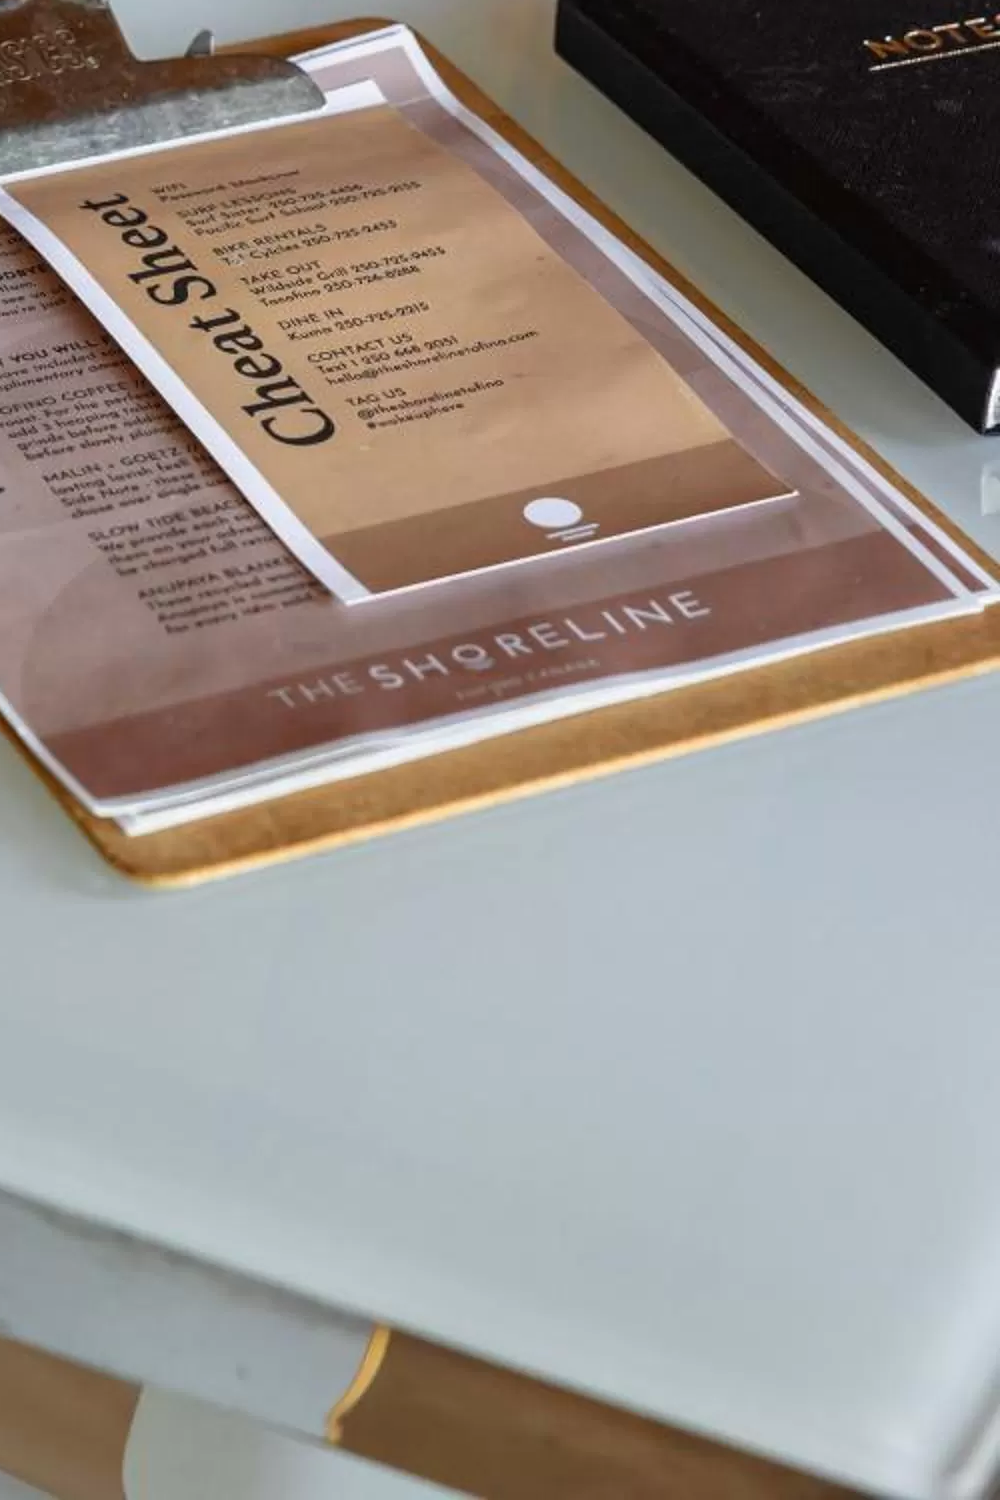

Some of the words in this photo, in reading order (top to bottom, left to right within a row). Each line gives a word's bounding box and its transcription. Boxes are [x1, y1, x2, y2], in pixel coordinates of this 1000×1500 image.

[175, 203, 221, 219] SURF
[219, 187, 301, 209] LESSONS
[79, 194, 217, 305] Sheet
[211, 241, 251, 256] BIKE
[251, 223, 328, 247] RENTALS
[239, 269, 283, 285] TAKE
[285, 259, 321, 275] OUT
[248, 276, 313, 295] Wildside
[315, 266, 349, 280] Grill
[276, 312, 321, 330] DINE
[322, 307, 345, 319] IN
[286, 326, 333, 341] Kuma
[8, 348, 49, 364] YOU
[51, 340, 98, 354] WILL
[306, 338, 385, 364] CONTACT
[387, 332, 414, 345] US
[32, 352, 97, 373] included
[315, 361, 348, 374] Text
[360, 351, 391, 365] 250
[190, 308, 335, 445] Cheat
[60, 381, 127, 402] COFFEE
[344, 393, 381, 407] TAG
[381, 387, 407, 399] US
[41, 463, 103, 484] MALIN
[119, 446, 180, 467] GOETZ
[145, 511, 187, 528] TIDE
[267, 671, 365, 710] THE
[368, 589, 712, 691] SHORELINE
